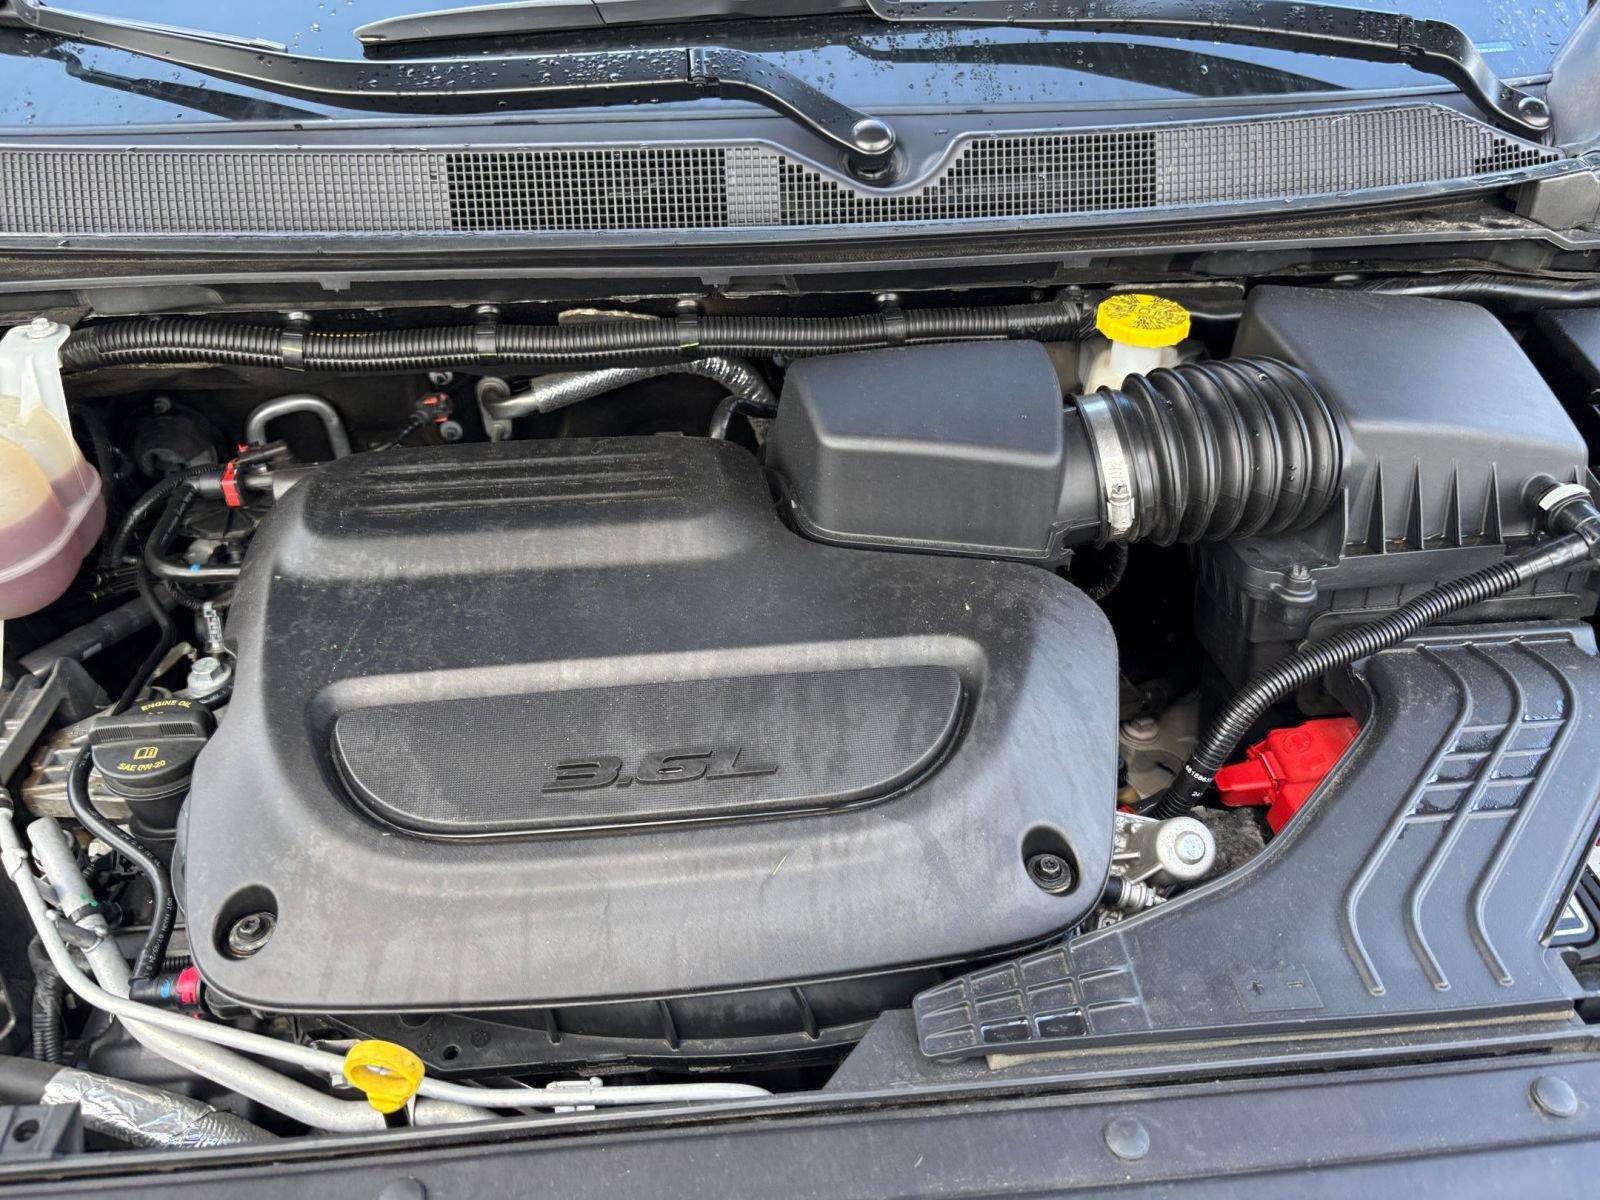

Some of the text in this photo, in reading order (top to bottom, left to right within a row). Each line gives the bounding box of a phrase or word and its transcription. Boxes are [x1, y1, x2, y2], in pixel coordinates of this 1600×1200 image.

[141, 699, 191, 711] ENGINE OIL
[117, 760, 166, 771] SAE 0W-20
[541, 746, 778, 794] 3.6L
